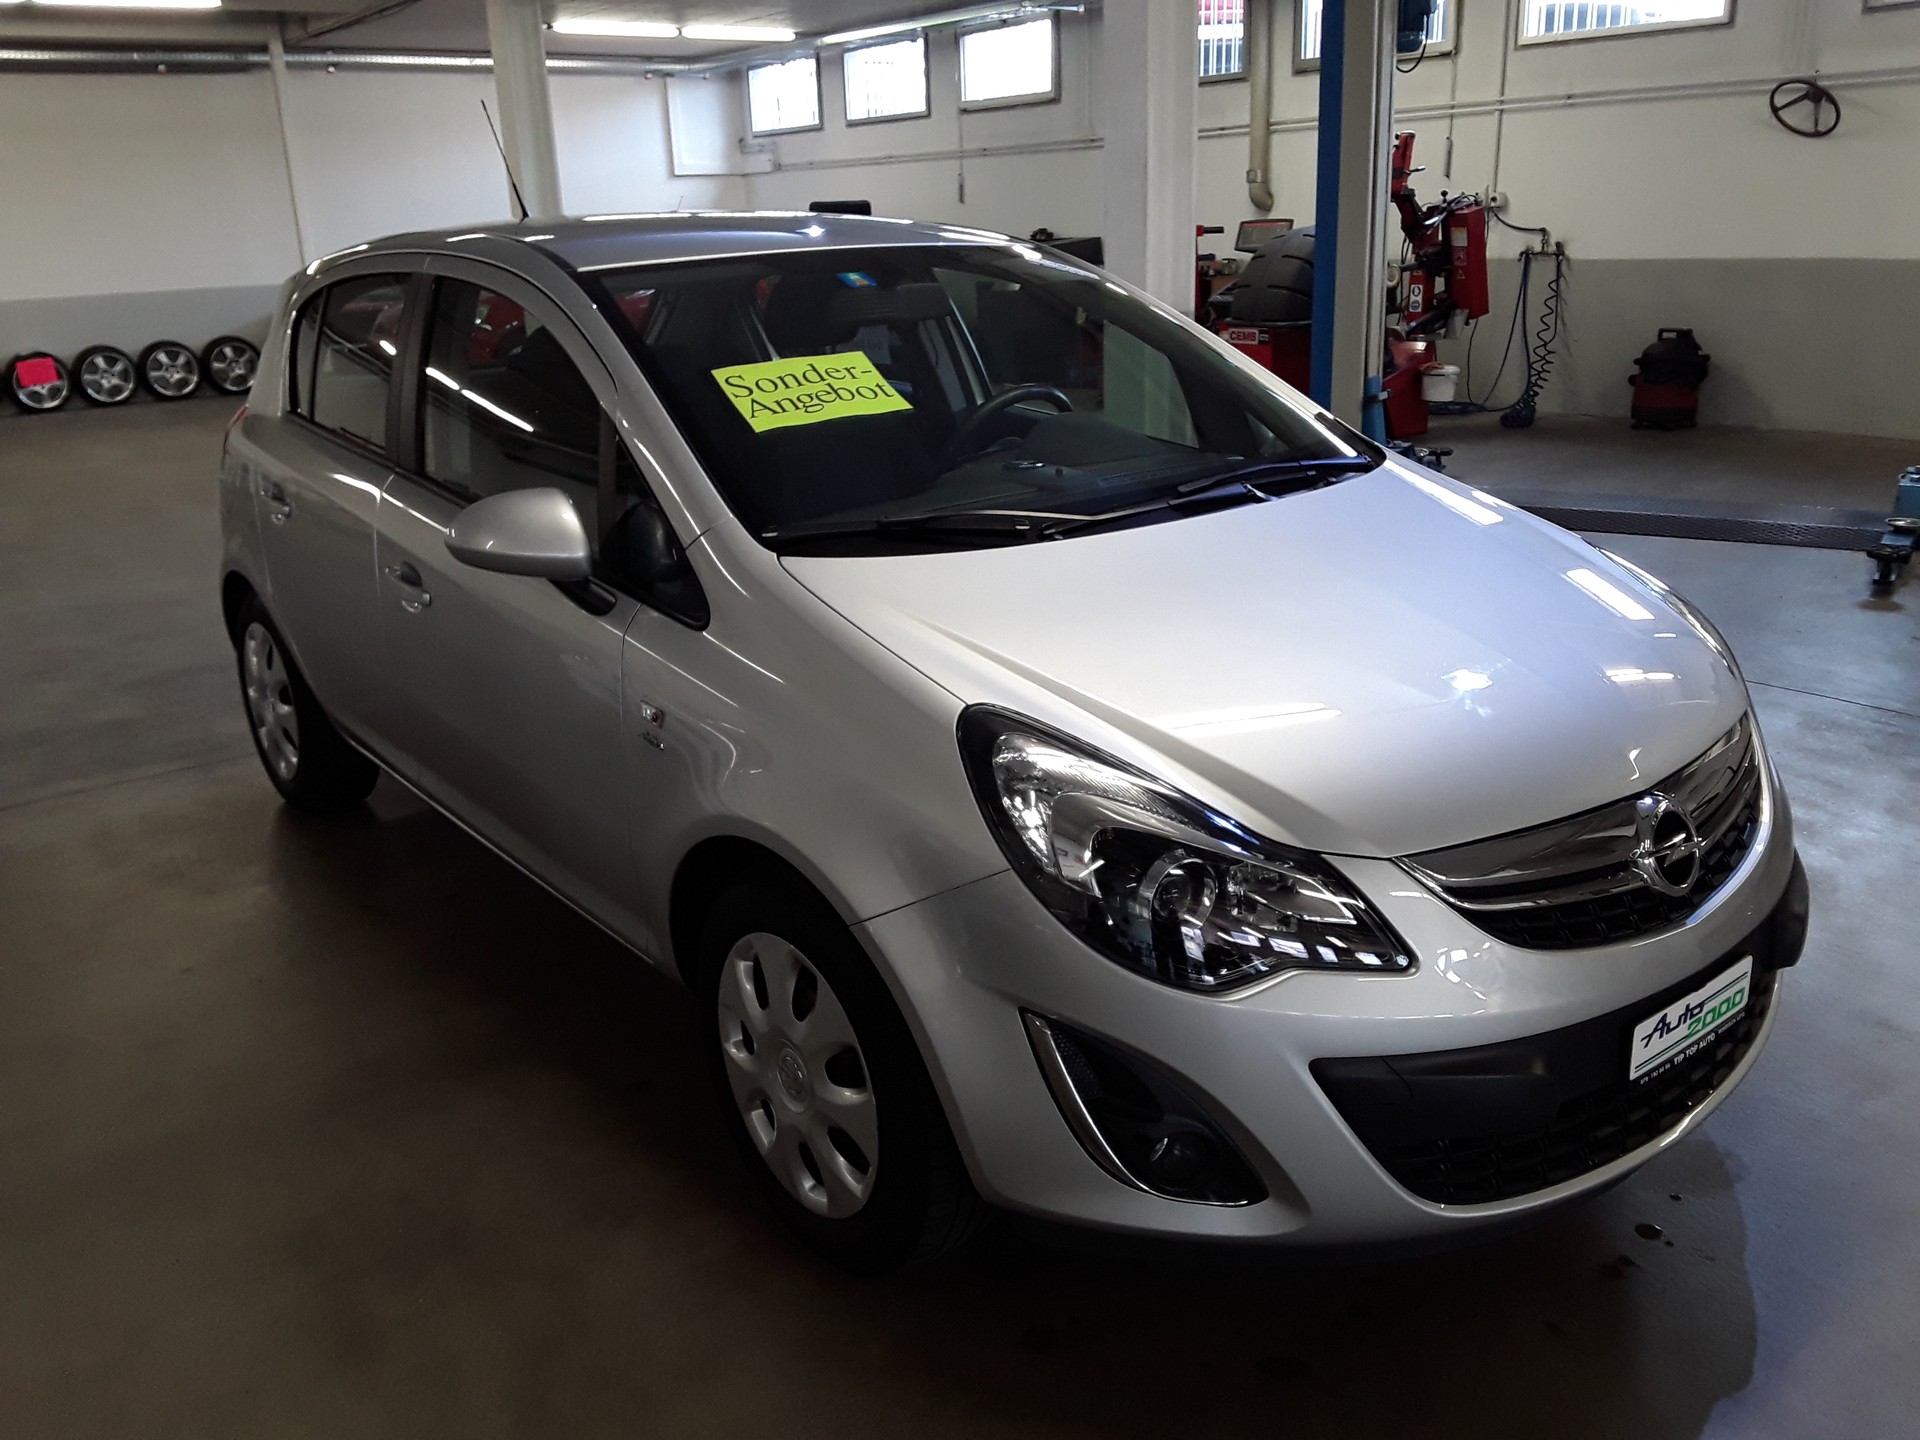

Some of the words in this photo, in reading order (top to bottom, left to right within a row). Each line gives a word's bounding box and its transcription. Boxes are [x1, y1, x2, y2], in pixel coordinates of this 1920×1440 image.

[725, 363, 872, 398] Sonder-
[749, 382, 895, 418] Angebot
[1641, 1002, 1705, 1048] Auto
[1686, 987, 1745, 1039] 2000
[1673, 1053, 1685, 1065] TIP
[1686, 1045, 1699, 1057] TOP
[1699, 1033, 1715, 1049] AUTO
